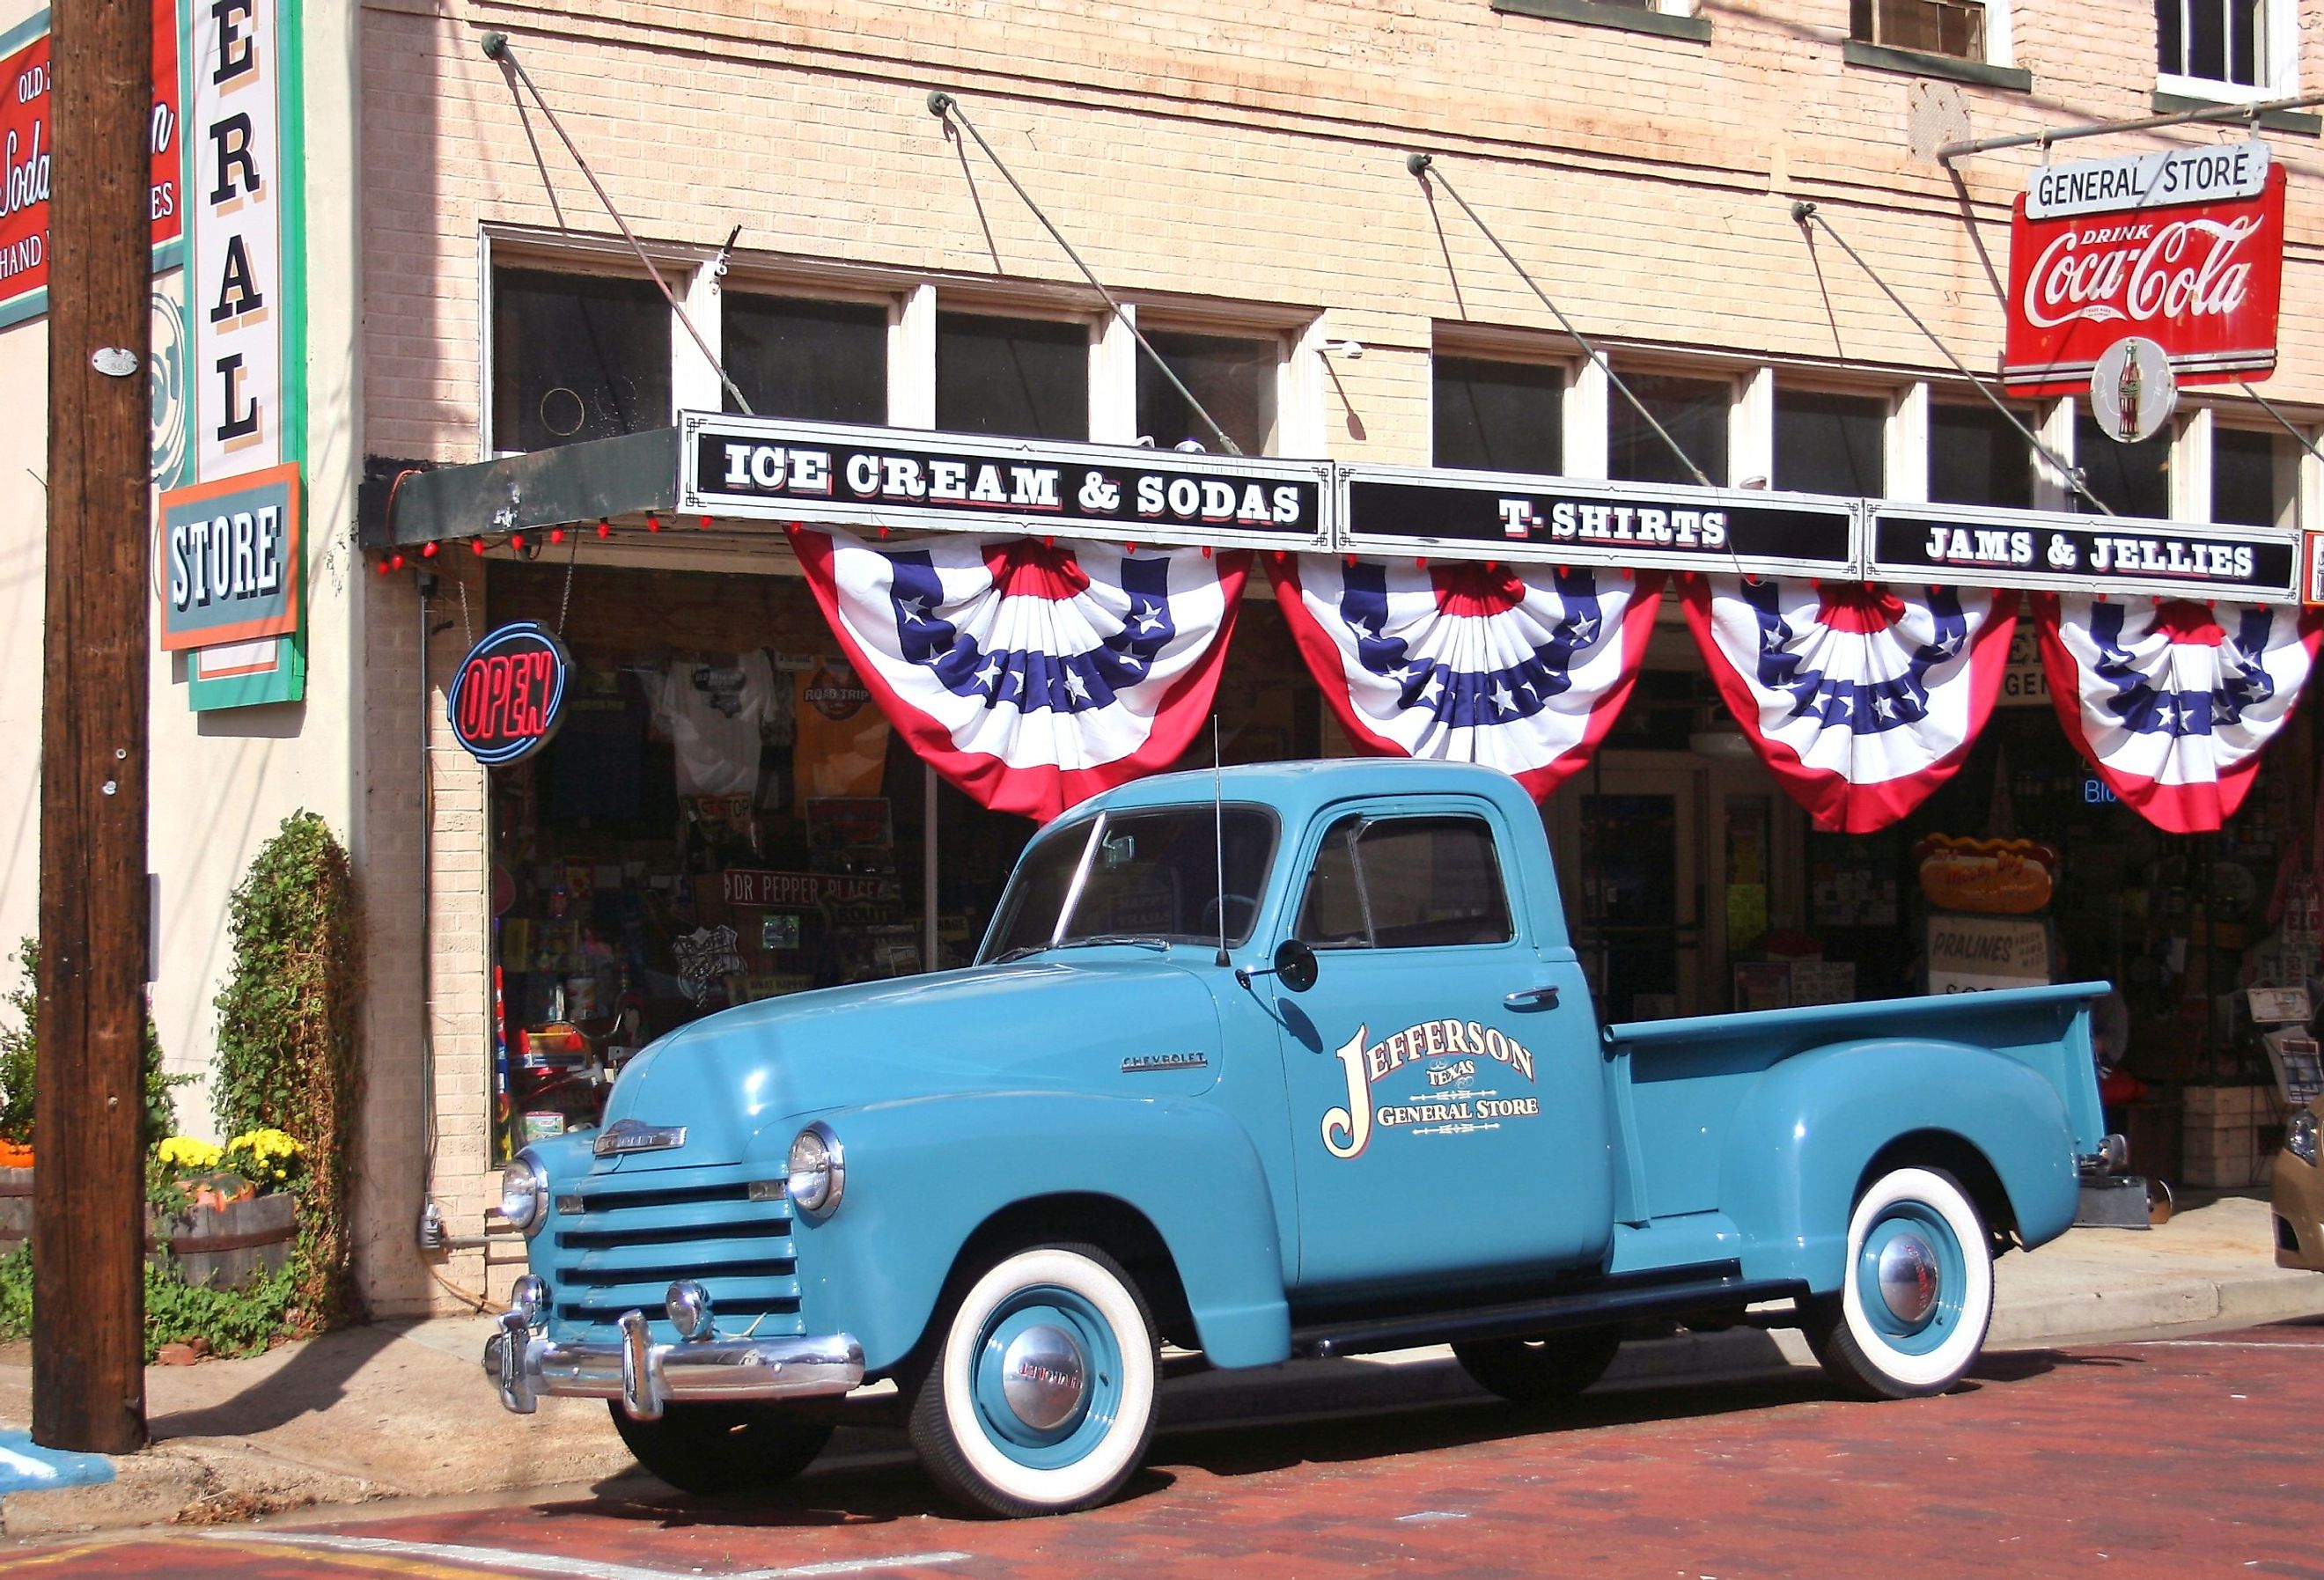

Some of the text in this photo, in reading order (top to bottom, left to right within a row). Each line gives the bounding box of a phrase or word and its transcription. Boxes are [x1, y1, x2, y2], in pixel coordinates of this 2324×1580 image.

[18, 66, 43, 104] OLD
[0, 119, 50, 218] Soda
[2038, 153, 2250, 207] GENERAL STORE
[2079, 224, 2153, 246] DRINK
[2023, 213, 2266, 328] Coca-Cola
[724, 443, 1301, 525] ICE CREAM & SODAS
[172, 504, 282, 613] STORE
[1925, 527, 2254, 578] JAMS & JELLIES
[460, 651, 553, 741] OPEN
[805, 687, 870, 702] ROAD TRIP
[2004, 672, 2046, 697] GE
[733, 874, 754, 900] DR
[762, 875, 820, 903] PEPPER
[1933, 931, 2013, 964] PRALINES
[1122, 1052, 1204, 1066] CHEVROLET
[1425, 1059, 1475, 1086] TEXAS
[1320, 1018, 1536, 1159] JEFFERSON
[1377, 1097, 1540, 1127] GENERAL STORE
